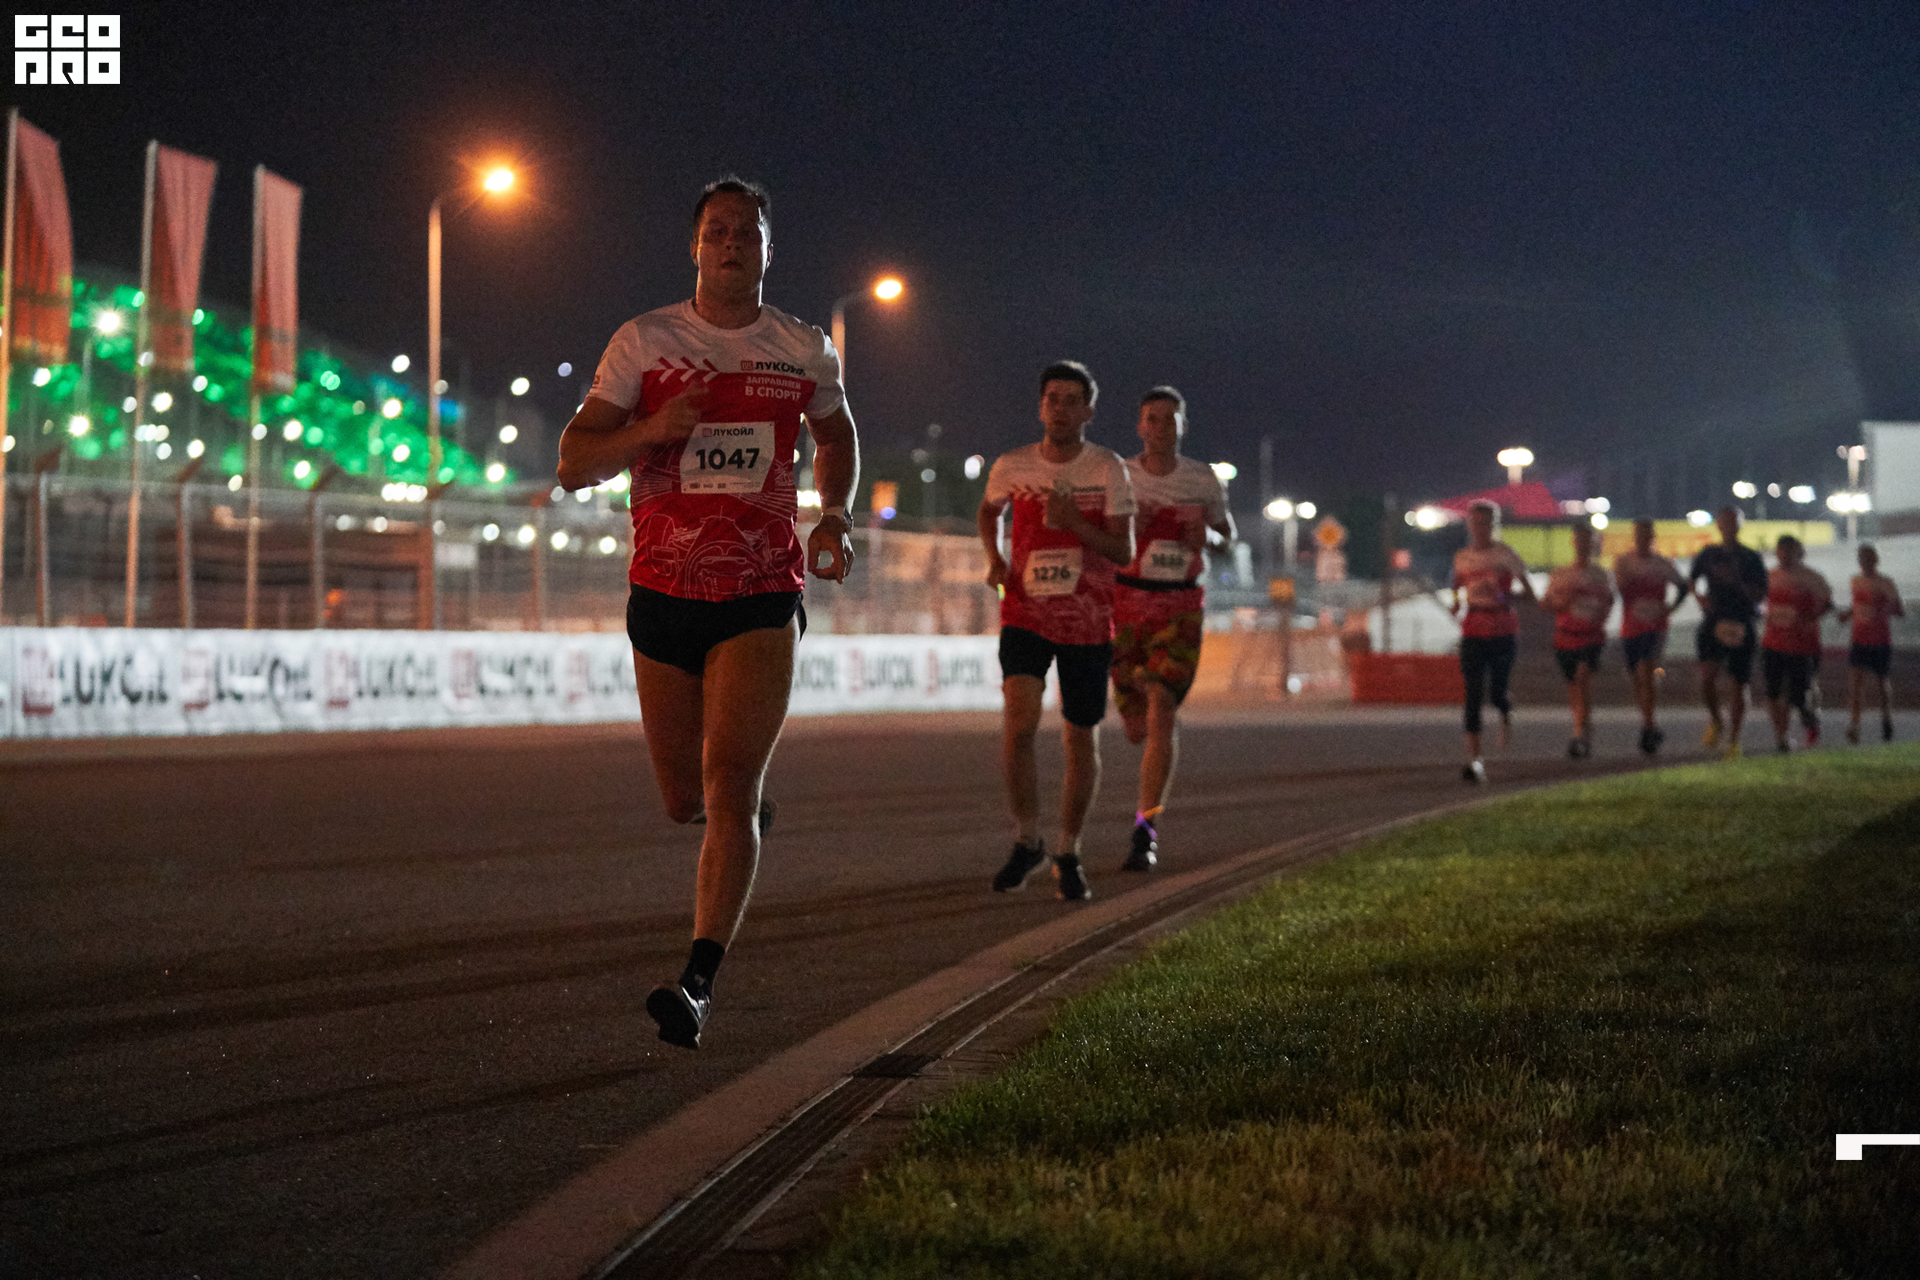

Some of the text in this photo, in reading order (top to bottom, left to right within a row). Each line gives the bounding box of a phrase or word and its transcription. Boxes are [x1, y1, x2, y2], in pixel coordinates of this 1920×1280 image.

[746, 386, 754, 396] В
[713, 427, 754, 437] ЛУКОЙЛ
[695, 448, 760, 470] 1047
